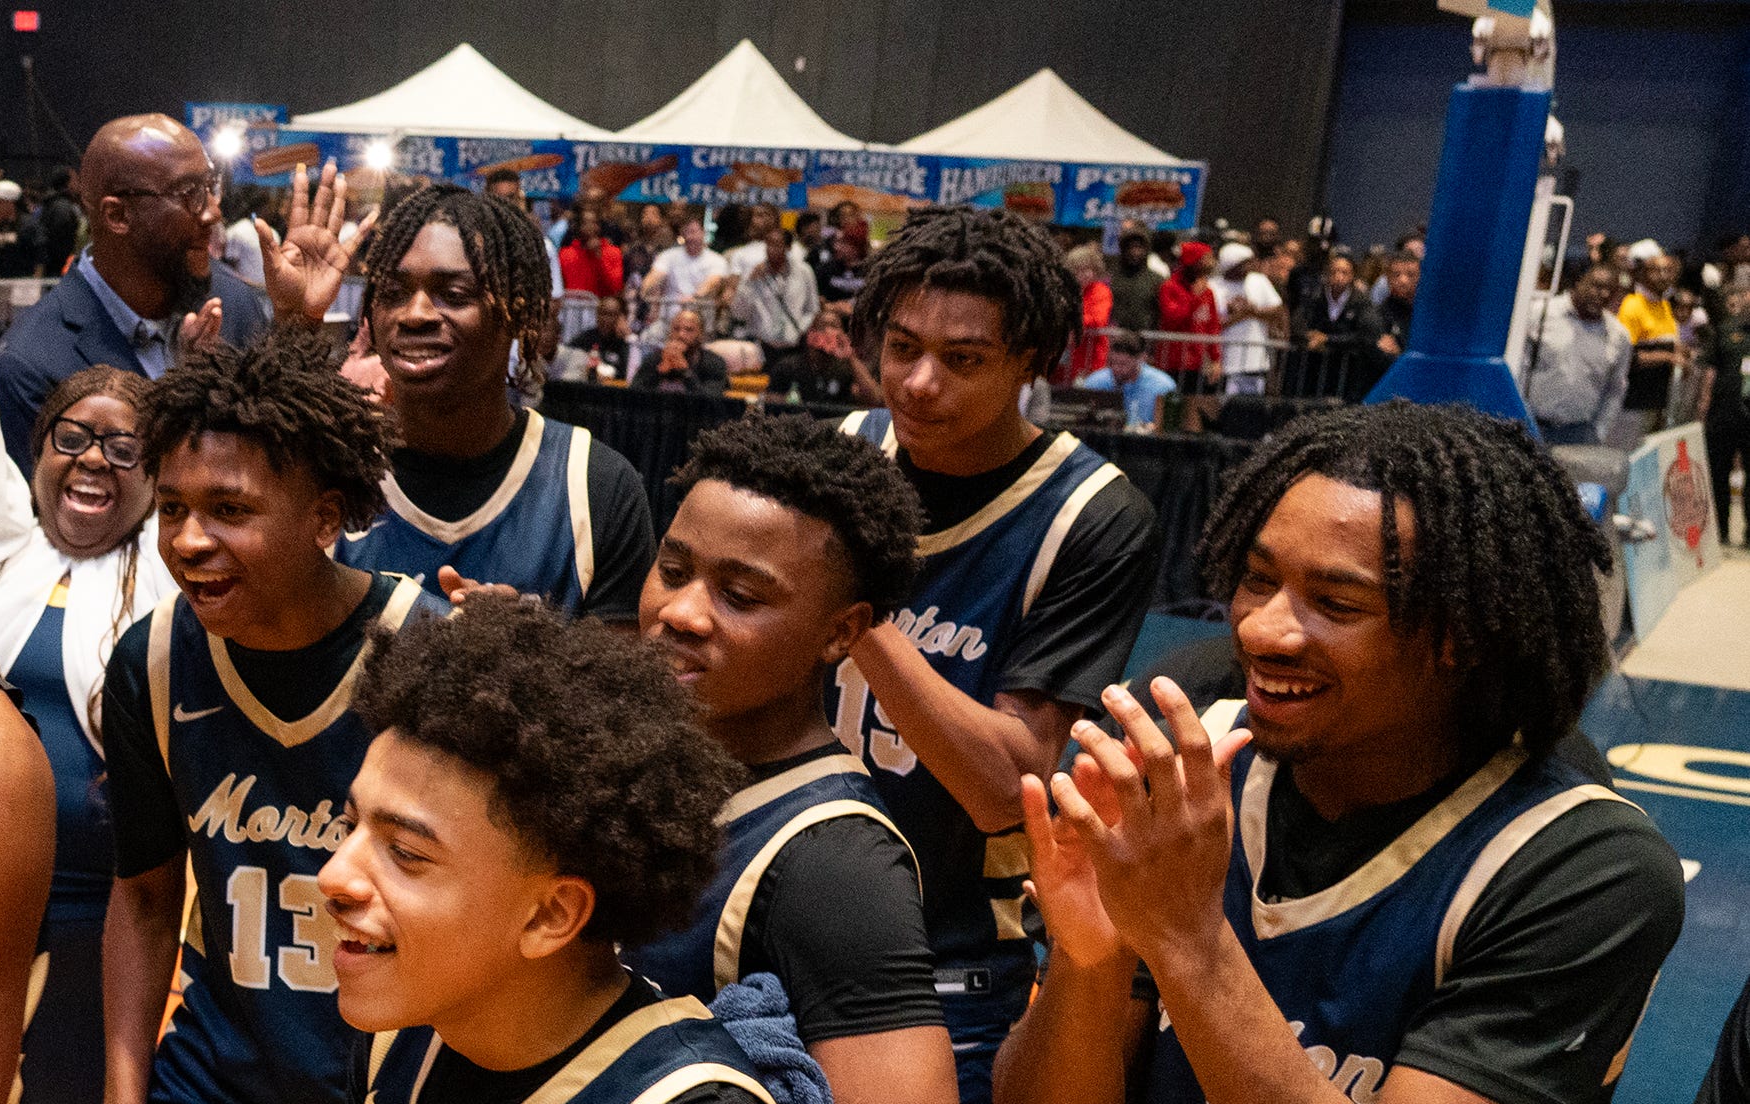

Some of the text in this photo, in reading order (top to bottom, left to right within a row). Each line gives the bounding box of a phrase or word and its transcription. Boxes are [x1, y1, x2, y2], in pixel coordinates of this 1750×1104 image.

[691, 149, 807, 169] CHICKEN
[818, 152, 919, 172] NACHOS
[841, 167, 928, 195] CHEESE
[886, 606, 988, 661] rton
[188, 771, 349, 852] Morto
[227, 865, 340, 994] 13
